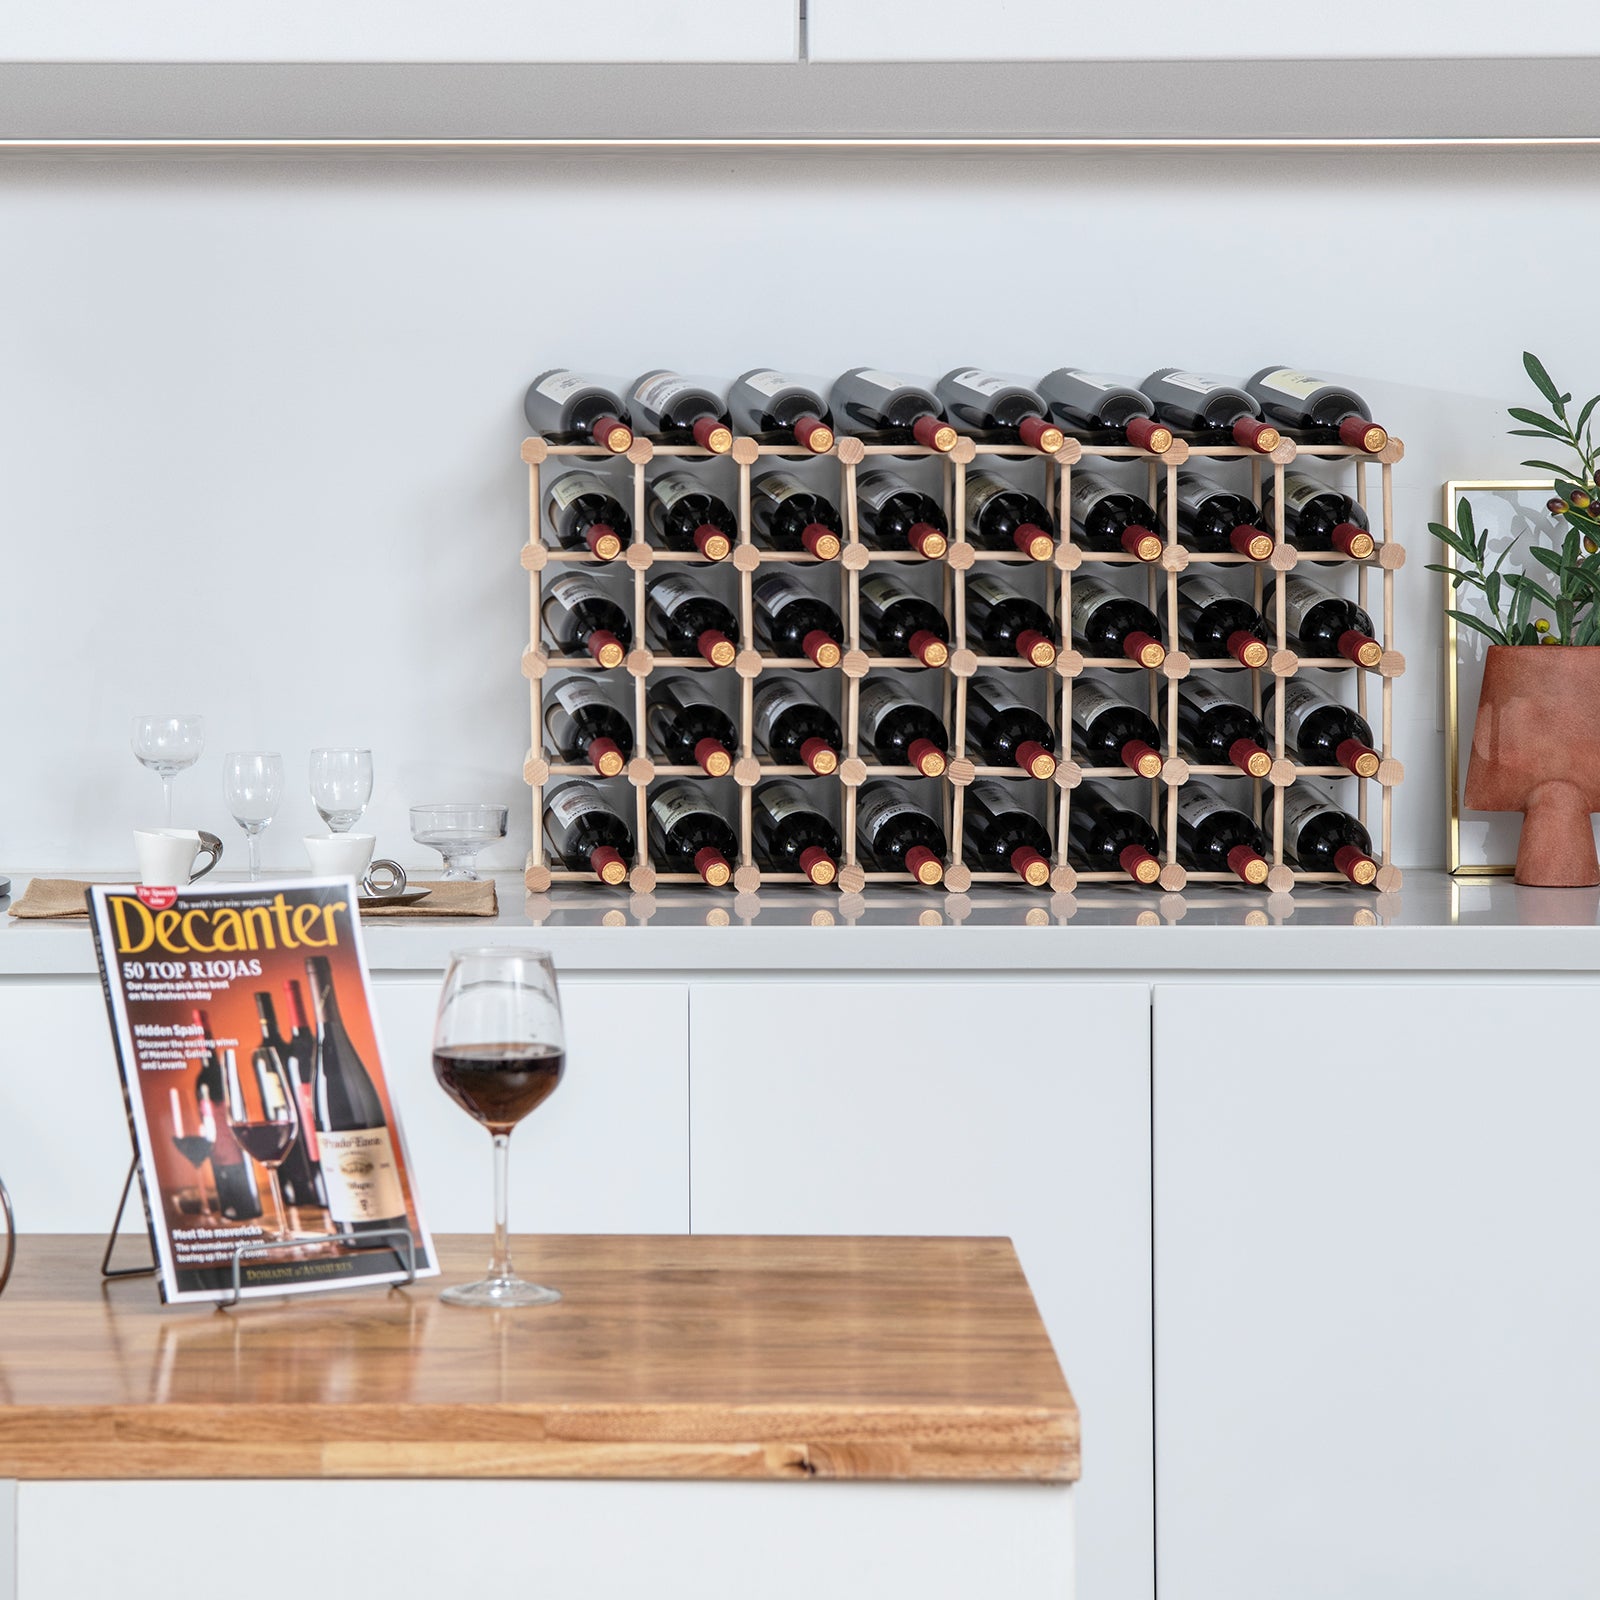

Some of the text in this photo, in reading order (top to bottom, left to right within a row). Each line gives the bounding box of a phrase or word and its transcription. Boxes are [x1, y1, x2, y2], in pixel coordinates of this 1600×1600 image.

[140, 888, 150, 896] The
[108, 893, 347, 954] Decanter
[123, 959, 263, 980] 50 TOP RIOJAS
[126, 980, 229, 991] Our experts pick the best
[128, 991, 212, 1001] on the shelves today
[134, 1024, 204, 1038] Hidden Spain
[137, 1038, 239, 1049] Discover the exciting wines
[139, 1050, 149, 1059] of
[141, 1060, 187, 1070] and Levante
[172, 1225, 263, 1240] Meet the mavericks
[175, 1243, 190, 1252] The
[190, 1241, 235, 1252] winemakers
[214, 1252, 228, 1262] the
